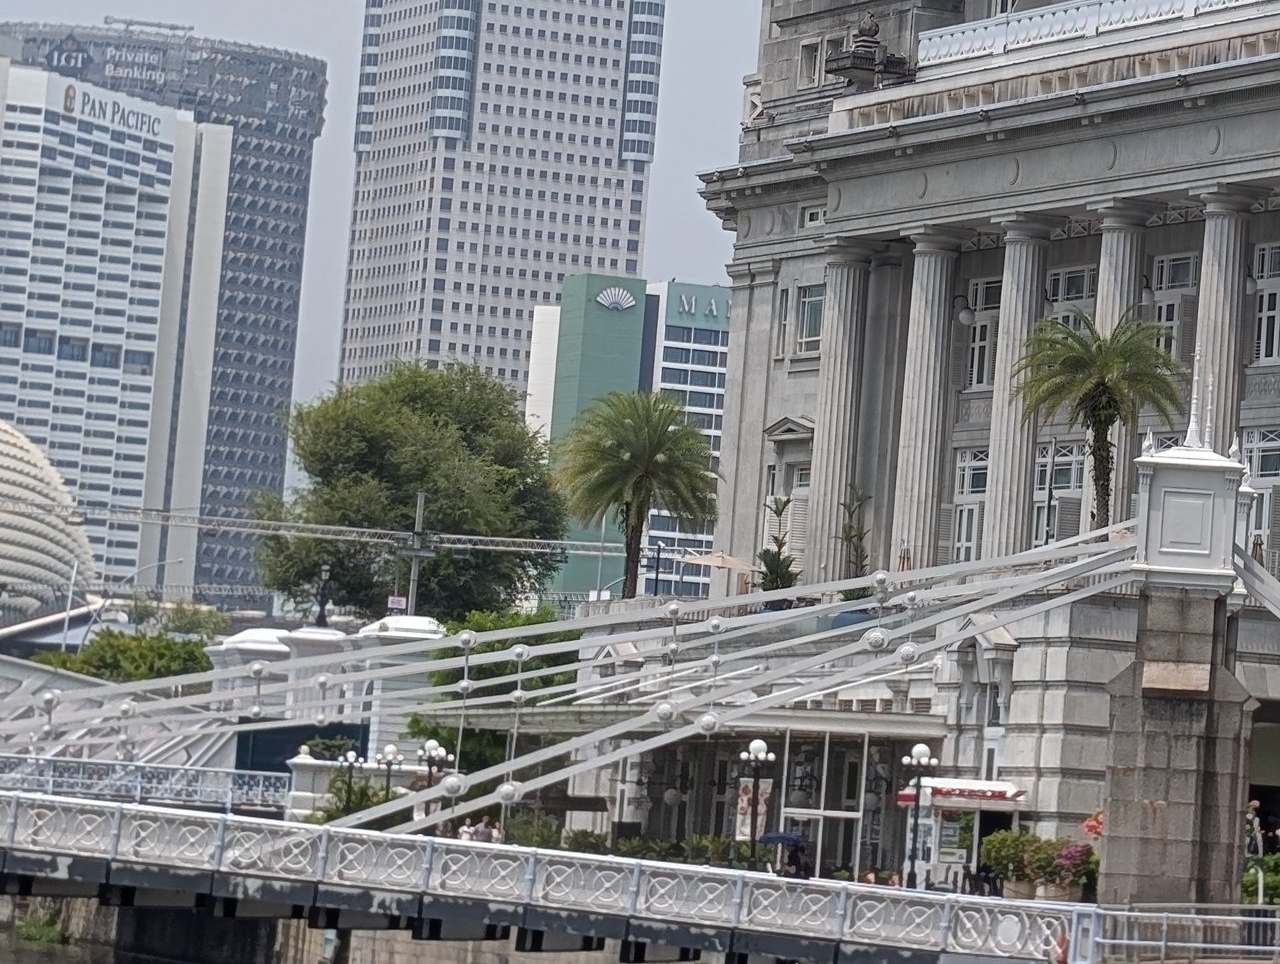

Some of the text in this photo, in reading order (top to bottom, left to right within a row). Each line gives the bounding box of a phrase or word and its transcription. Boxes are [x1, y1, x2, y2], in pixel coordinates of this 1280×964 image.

[52, 50, 88, 68] LGT
[105, 46, 160, 65] Private
[105, 63, 166, 85] Banking
[81, 91, 162, 137] PAN PACIFIC
